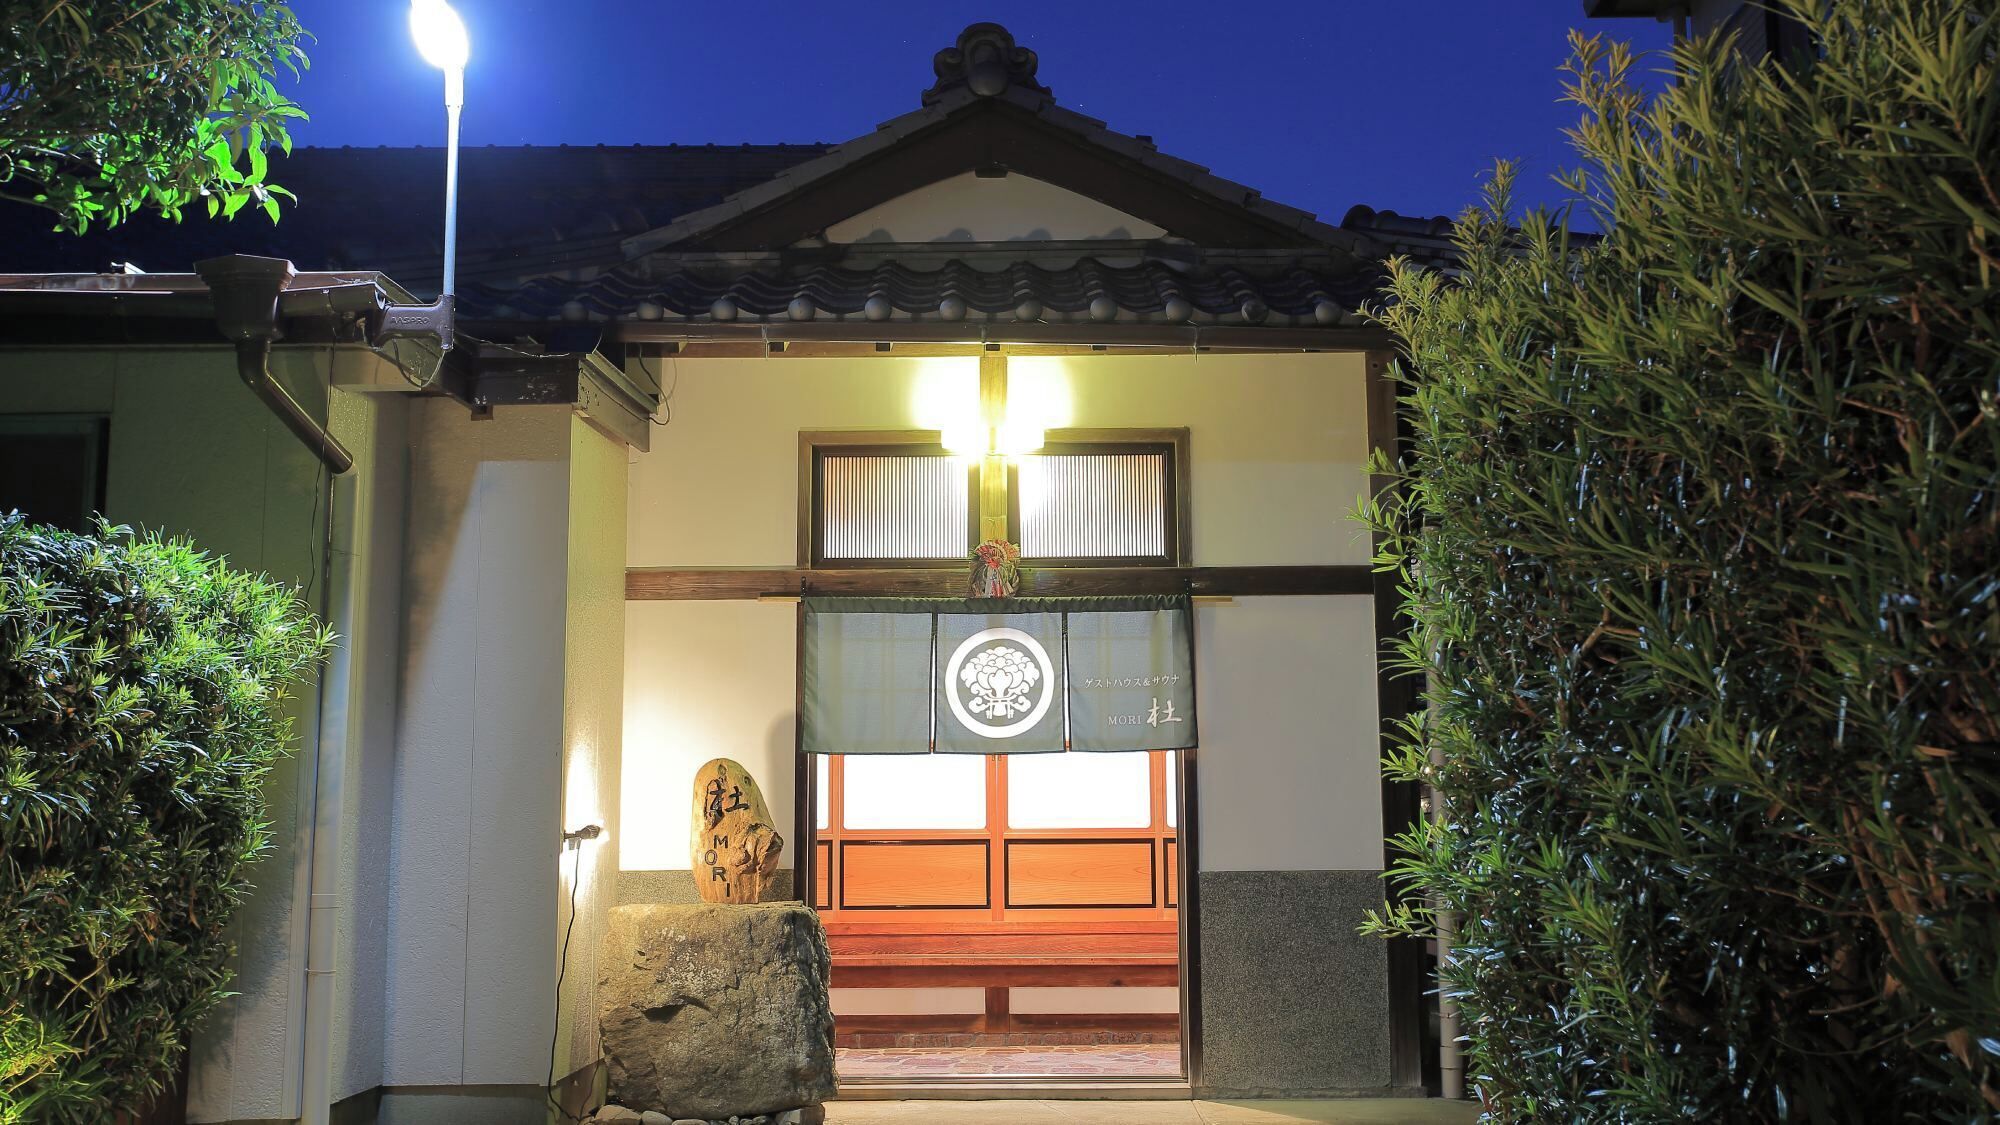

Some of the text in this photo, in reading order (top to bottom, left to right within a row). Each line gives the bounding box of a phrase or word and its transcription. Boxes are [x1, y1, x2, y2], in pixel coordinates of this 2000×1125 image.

[1108, 697, 1183, 728] MORI 杜
[704, 834, 731, 898] MORI
